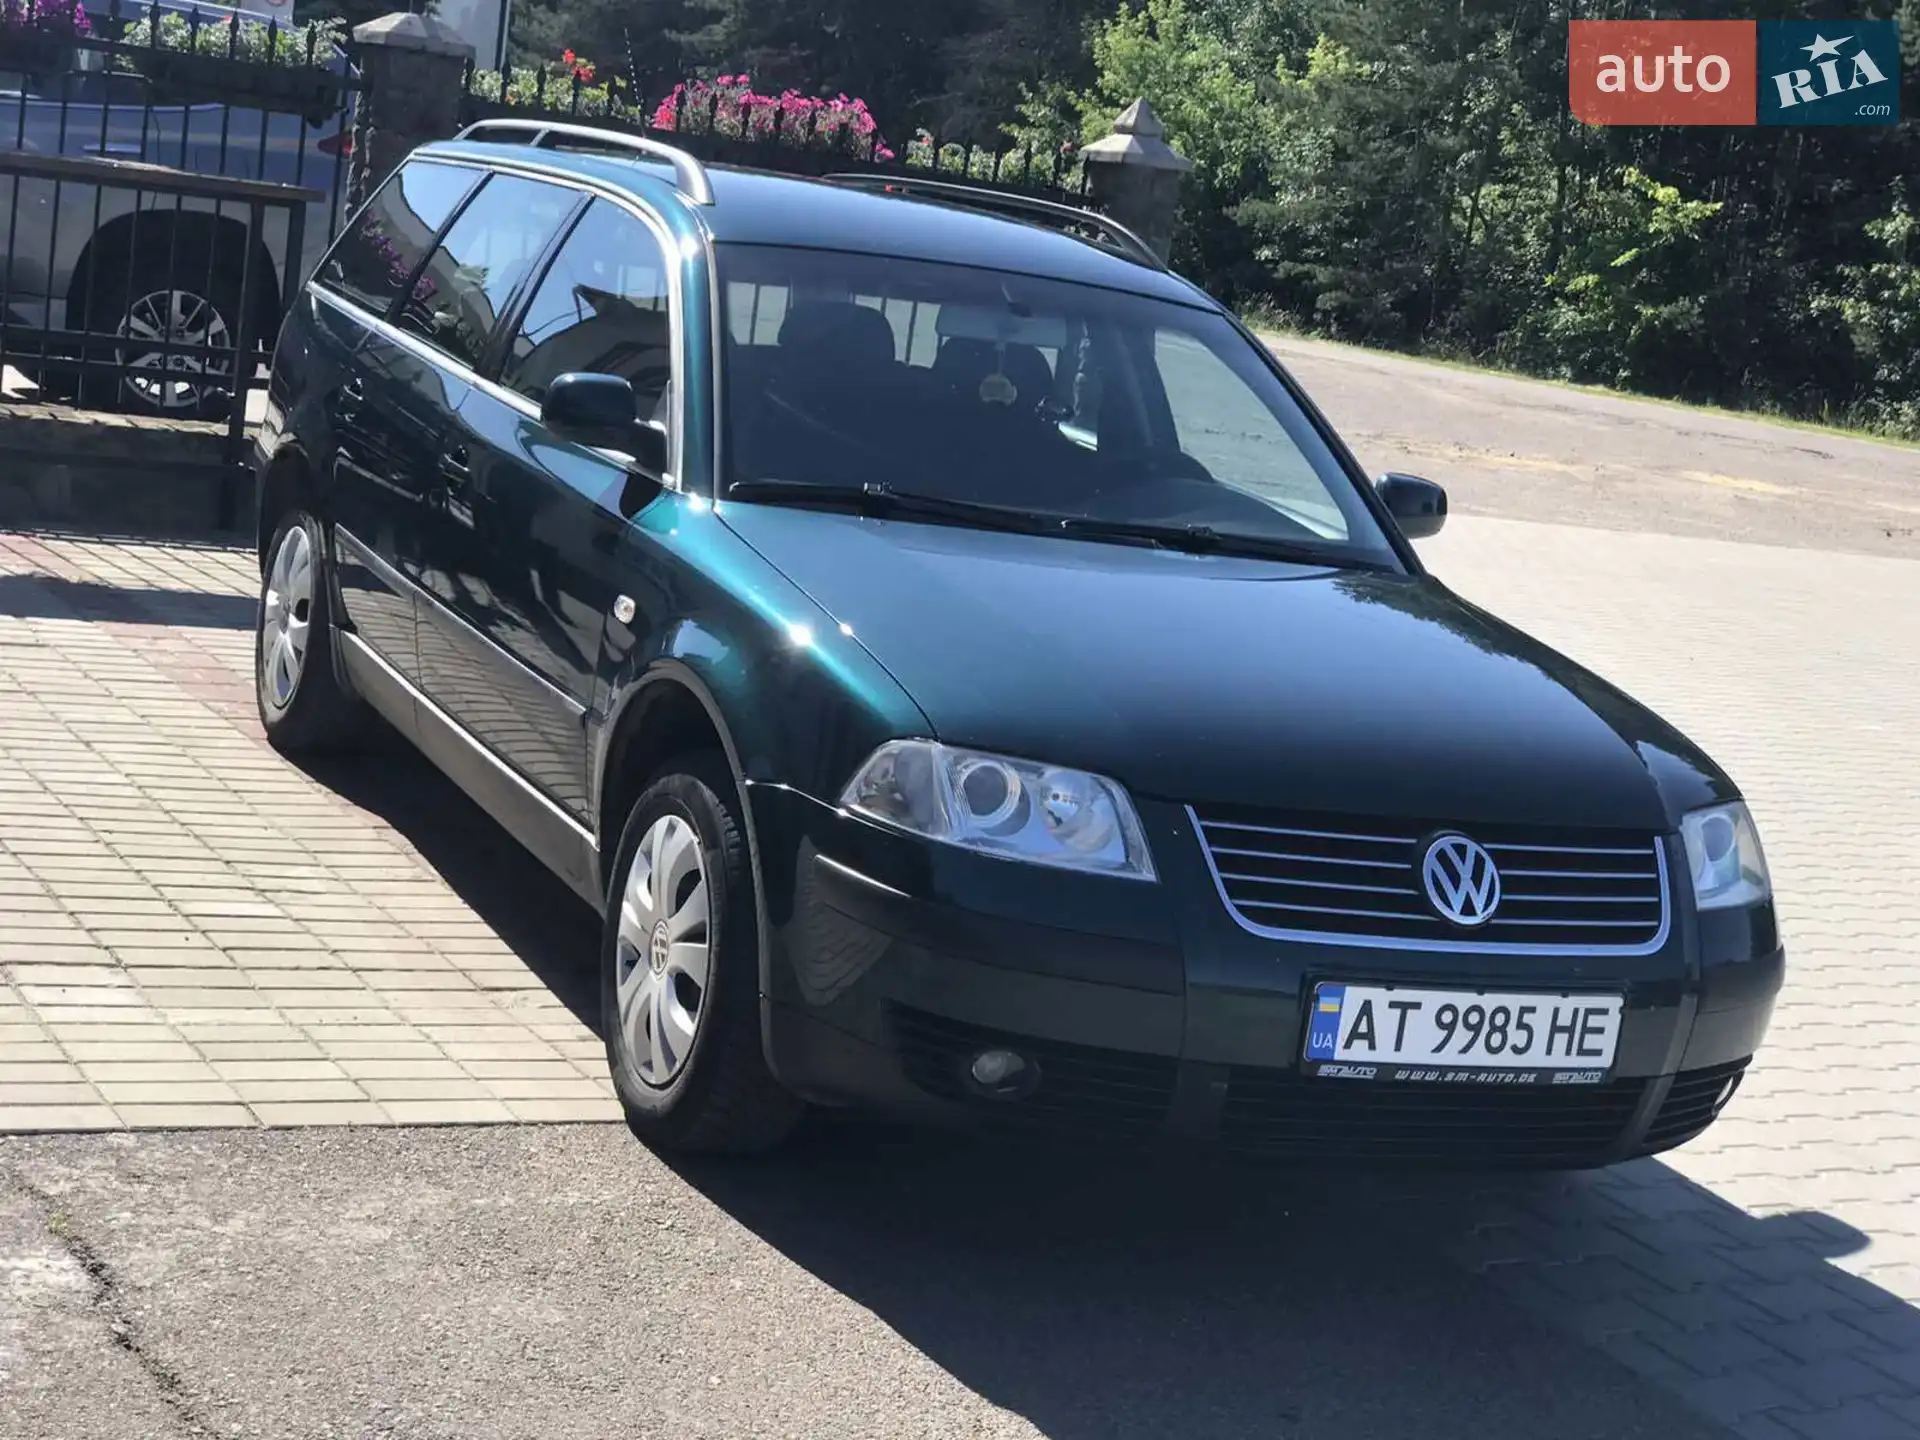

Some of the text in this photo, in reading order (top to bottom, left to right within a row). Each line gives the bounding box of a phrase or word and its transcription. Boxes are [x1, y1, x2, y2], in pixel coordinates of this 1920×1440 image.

[1312, 1031, 1333, 1049] UA
[1343, 999, 1610, 1057] AT 9985 HE
